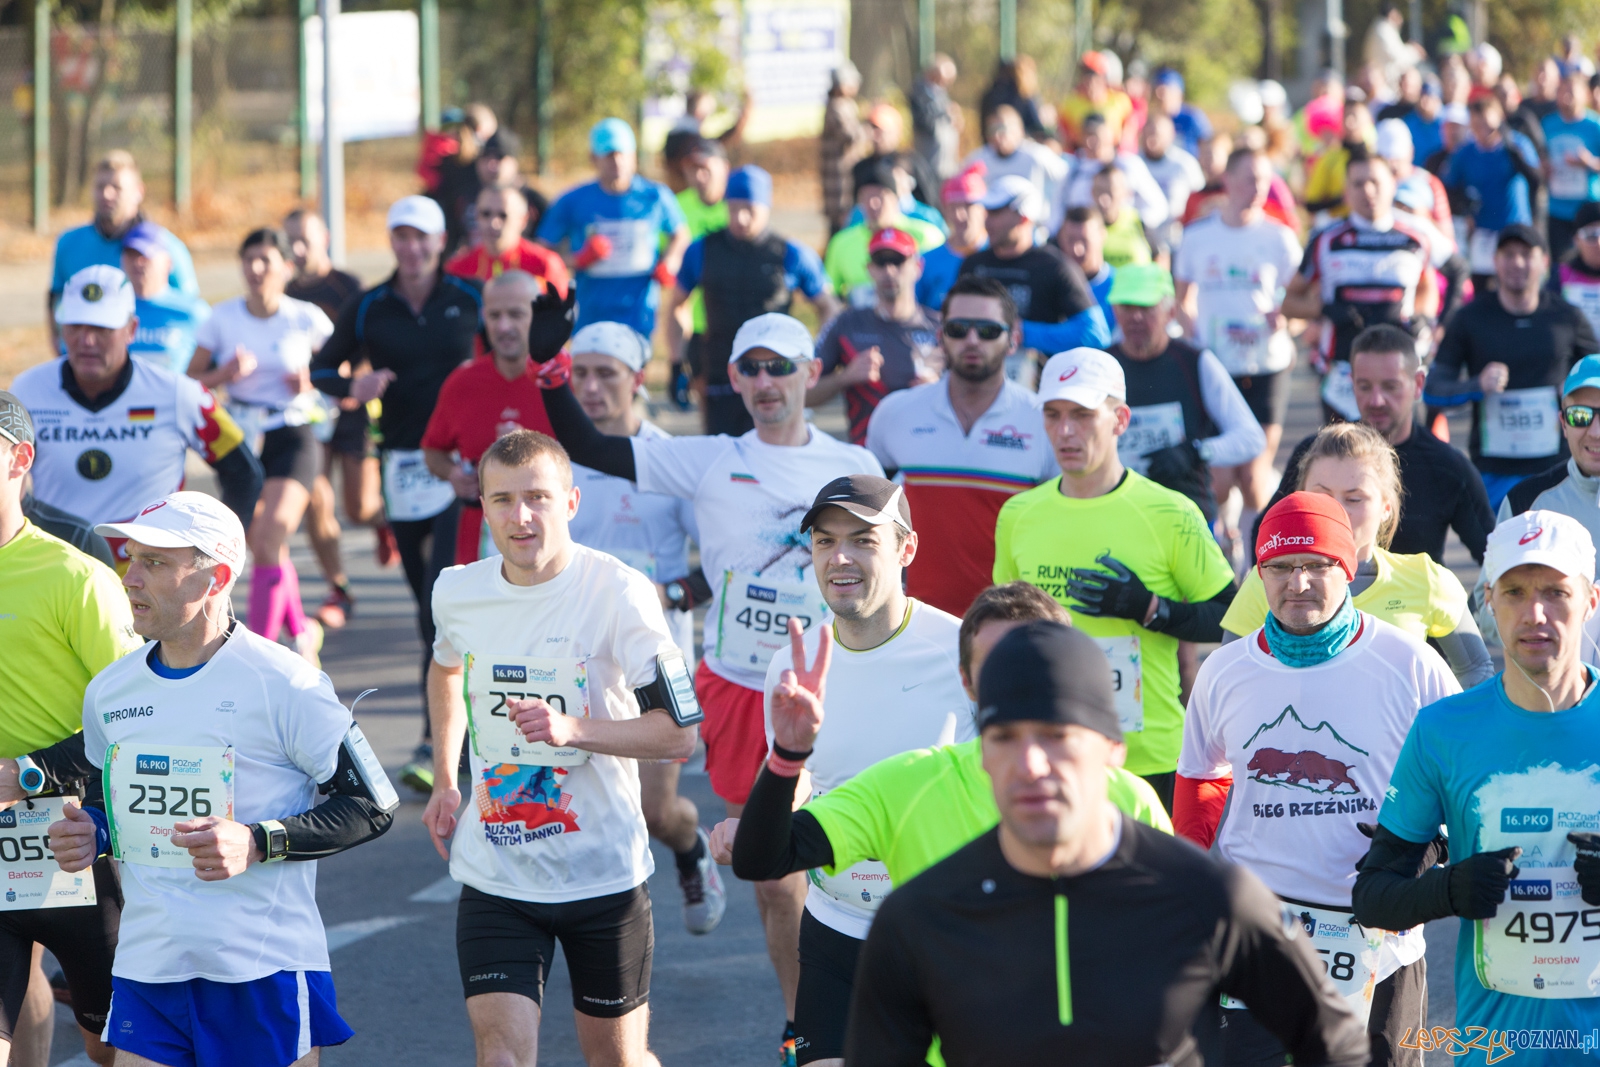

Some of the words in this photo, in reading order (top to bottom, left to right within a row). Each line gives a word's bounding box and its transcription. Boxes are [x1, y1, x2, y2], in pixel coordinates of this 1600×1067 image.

[38, 425, 154, 441] GERMANY
[110, 705, 154, 722] PROMAG
[172, 766, 202, 774] maraton
[128, 783, 212, 817] 2326
[20, 816, 51, 824] maraton
[1558, 820, 1599, 829] maraton
[524, 824, 562, 843] BANKU
[8, 871, 43, 880] Bartosz
[1504, 911, 1600, 943] 4975
